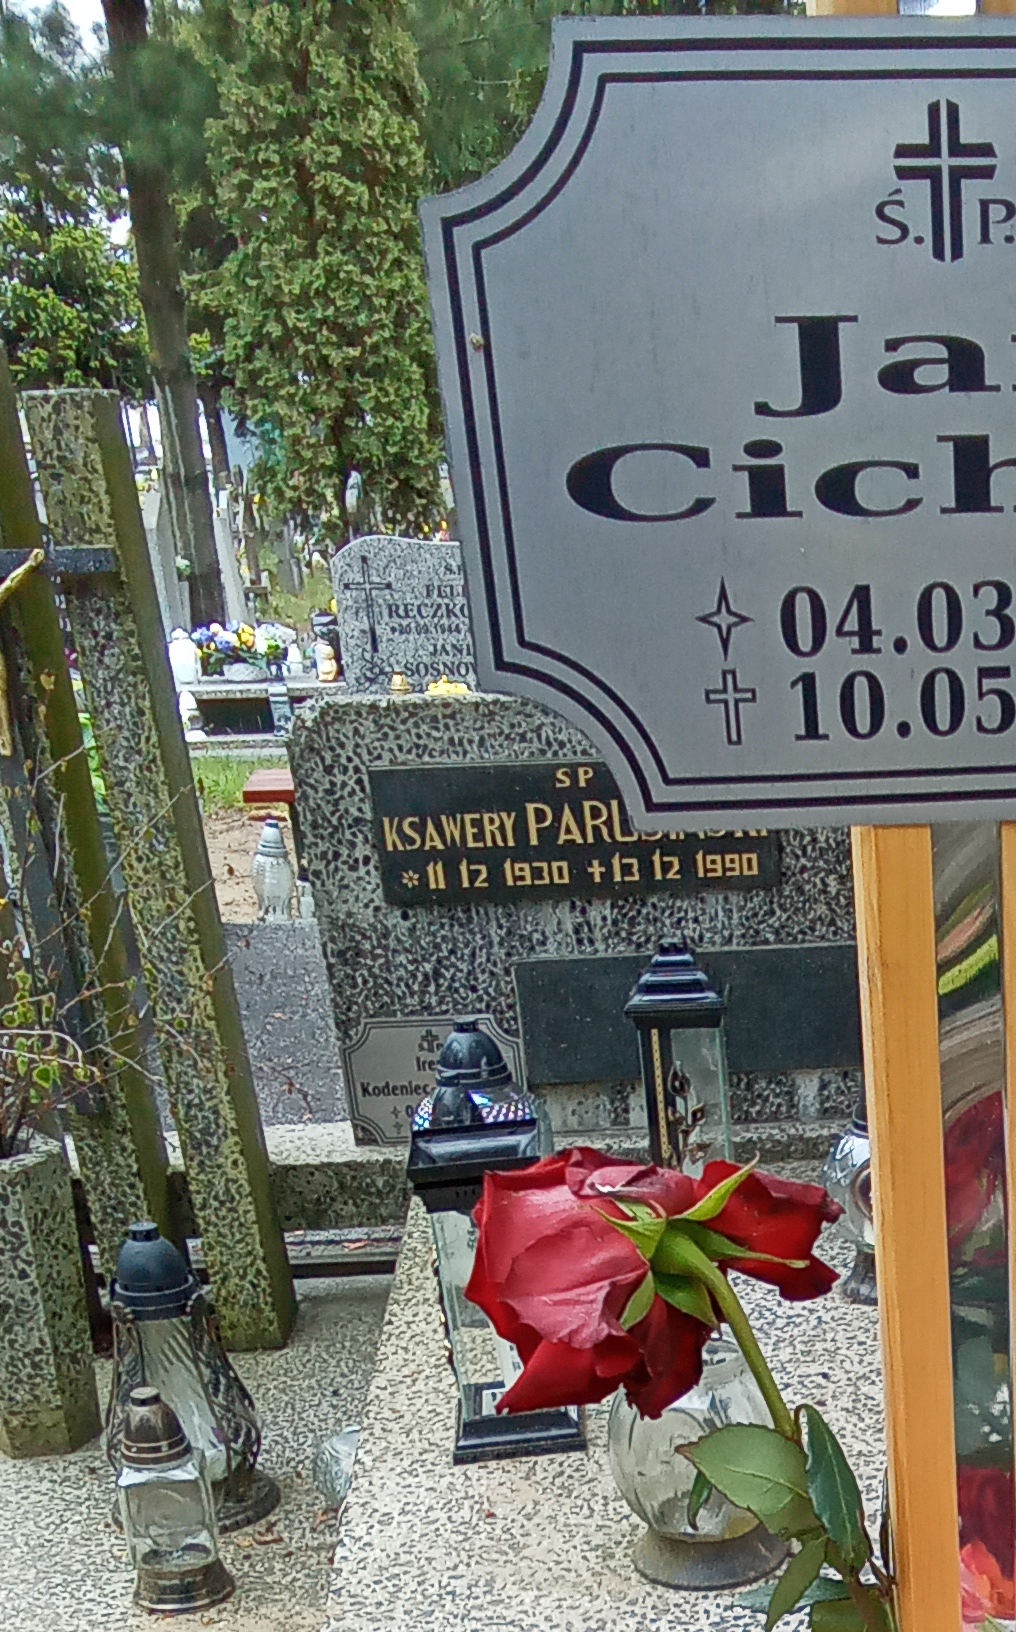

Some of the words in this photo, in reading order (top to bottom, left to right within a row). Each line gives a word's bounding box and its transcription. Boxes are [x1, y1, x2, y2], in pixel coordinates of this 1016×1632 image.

[382, 811, 516, 852] KSAWERY
[459, 859, 489, 889] 12
[503, 857, 570, 887] 1930
[651, 849, 681, 880] 12
[694, 849, 759, 879] 1990
[415, 1057, 438, 1072] Ire
